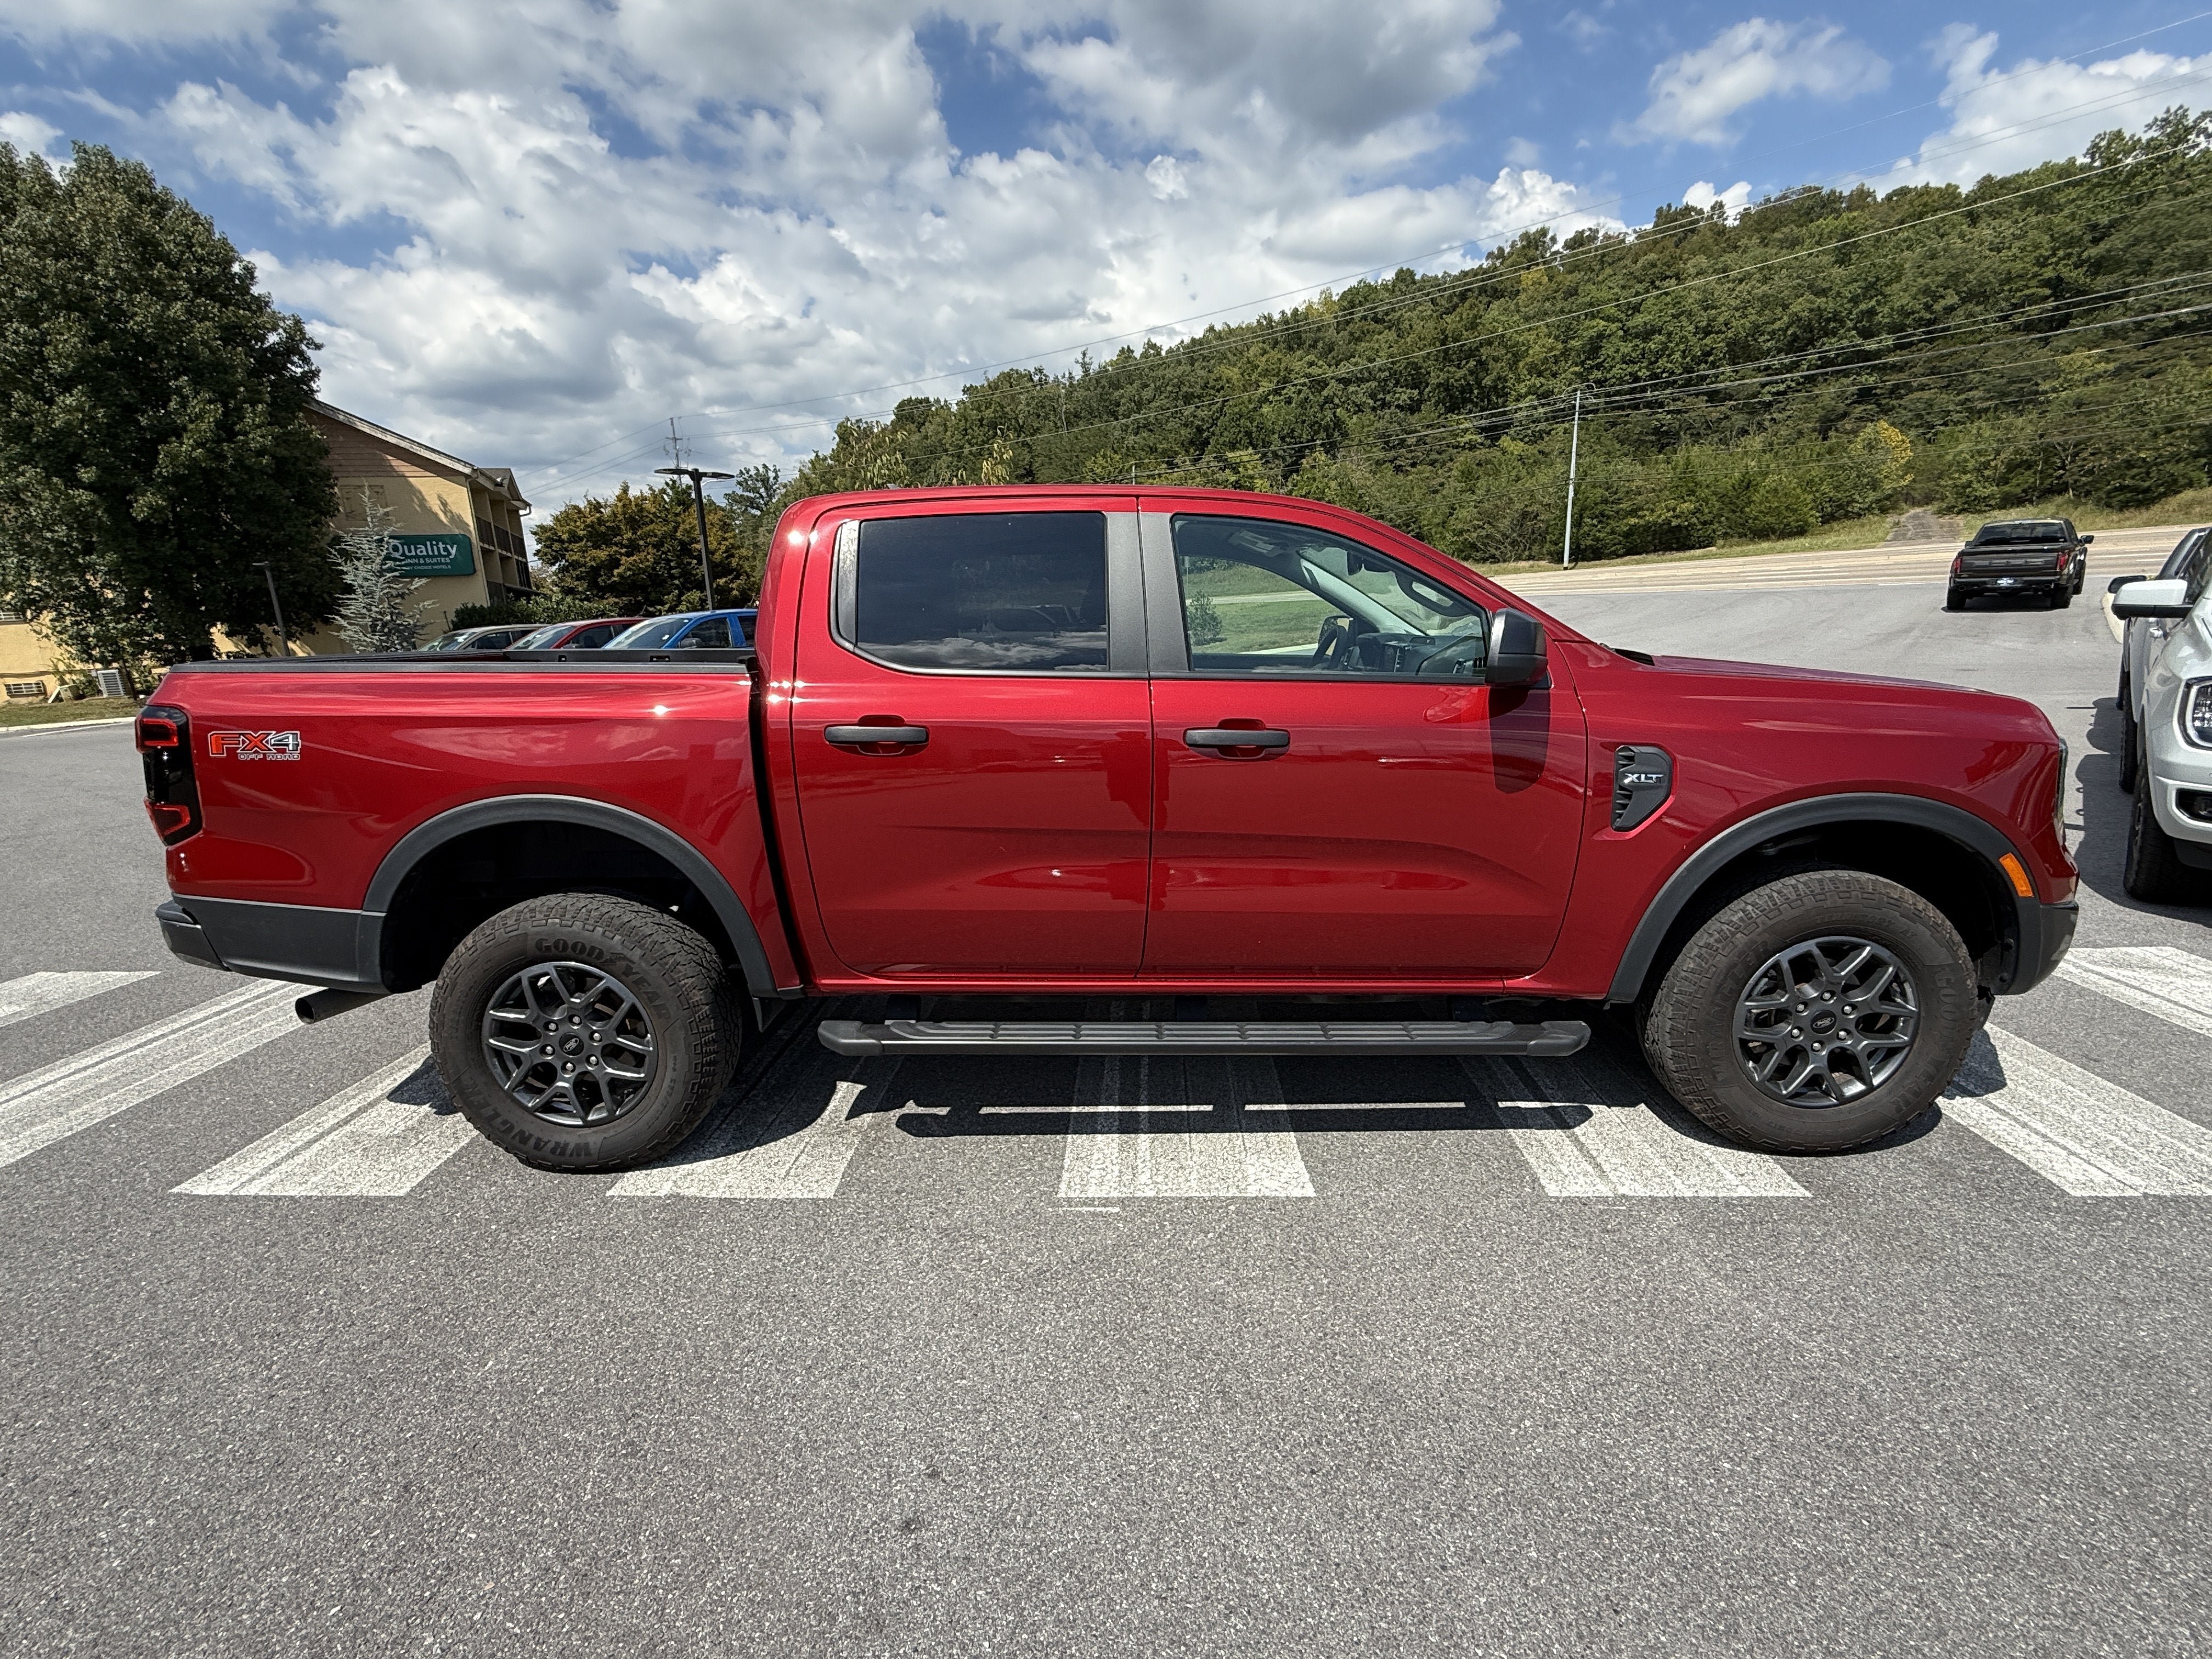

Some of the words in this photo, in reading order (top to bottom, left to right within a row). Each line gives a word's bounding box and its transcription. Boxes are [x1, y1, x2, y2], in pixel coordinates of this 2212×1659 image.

[389, 541, 457, 559] Quality
[208, 731, 301, 757] FX4
[1623, 773, 1664, 784] XLT
[535, 938, 672, 1019] GOODYEAR
